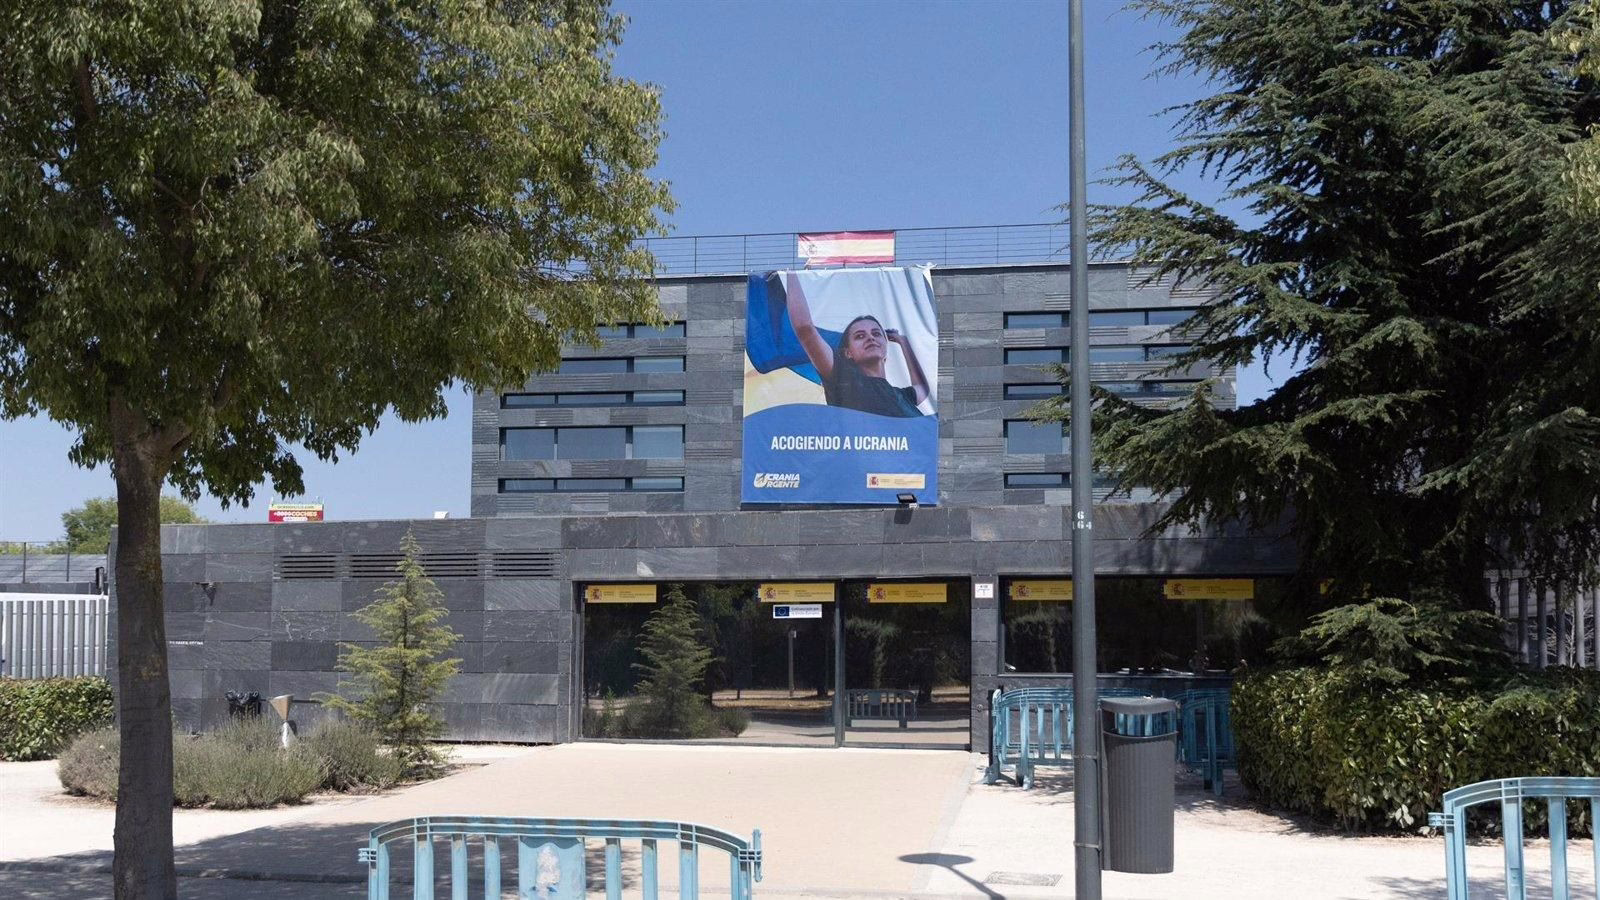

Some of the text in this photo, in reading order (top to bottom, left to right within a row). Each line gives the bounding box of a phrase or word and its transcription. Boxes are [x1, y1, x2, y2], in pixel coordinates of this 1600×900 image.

[771, 436, 909, 451] ACOGIENDO A UCRANIA
[1077, 510, 1085, 519] 6
